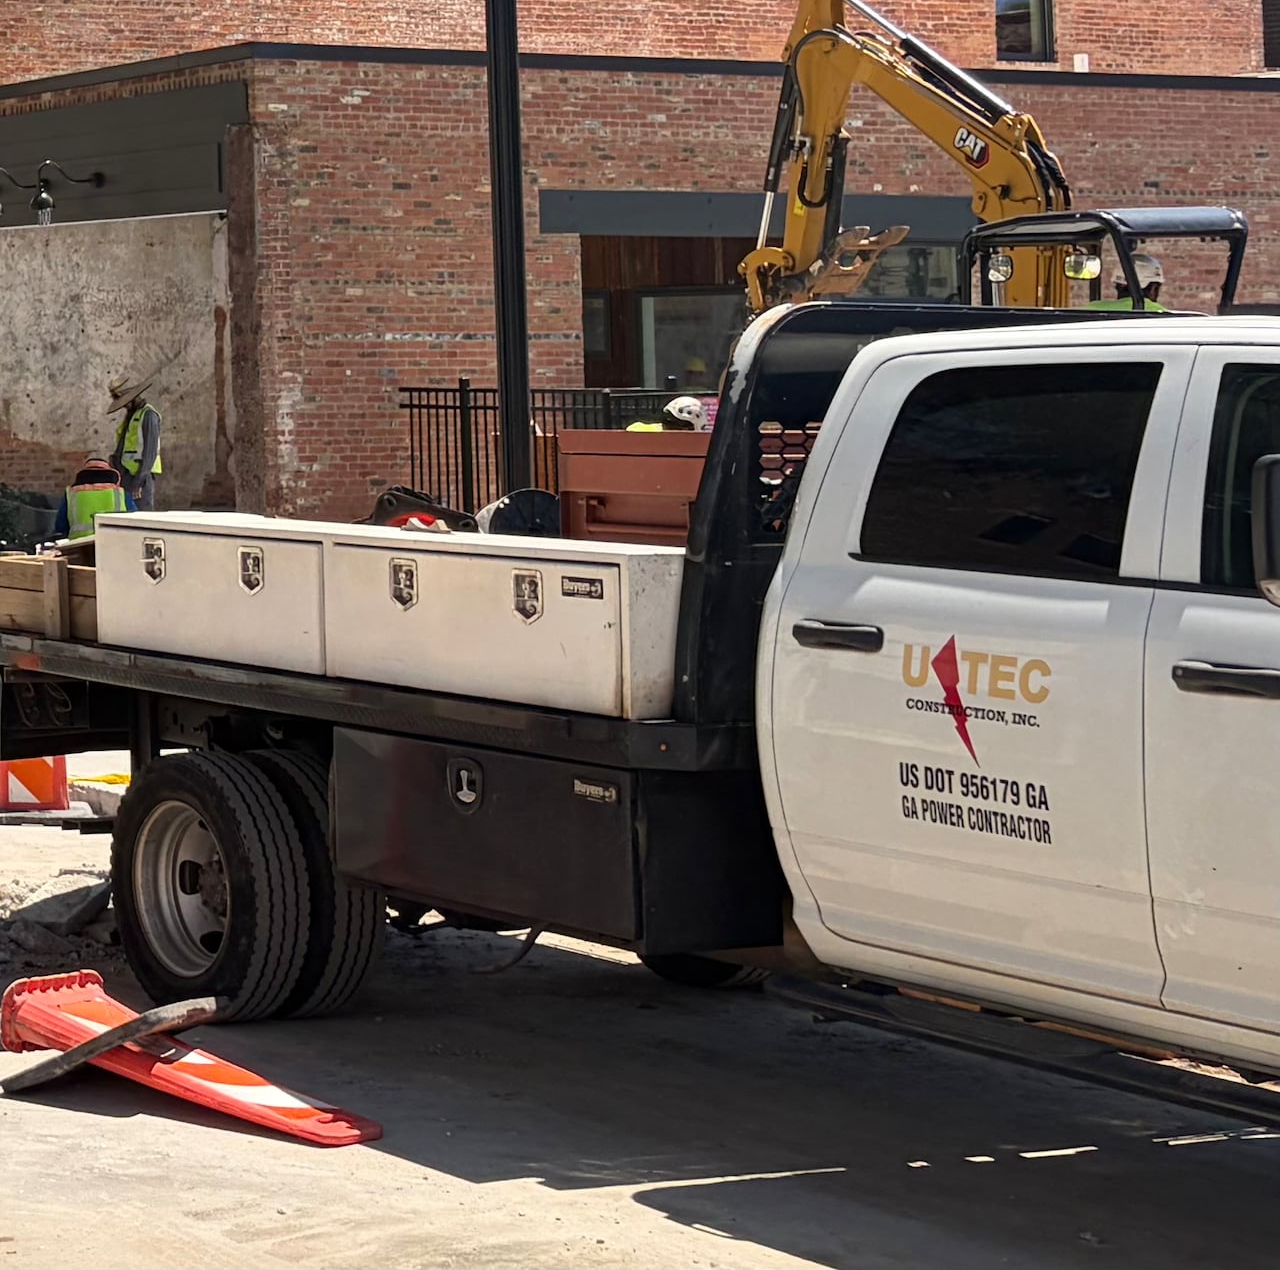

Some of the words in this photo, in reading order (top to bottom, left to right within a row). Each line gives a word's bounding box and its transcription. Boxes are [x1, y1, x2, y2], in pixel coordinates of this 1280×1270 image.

[953, 127, 986, 161] CAT
[906, 698, 1009, 726] CONSTRUCTION,
[1011, 712, 1041, 728] INC.
[899, 762, 919, 788] US
[924, 766, 955, 794] DOT
[960, 772, 1020, 806] 956179
[1025, 782, 1050, 811] GA
[901, 795, 919, 820] GA
[921, 798, 965, 828] POWER
[968, 807, 1052, 844] CONTRACTOR
